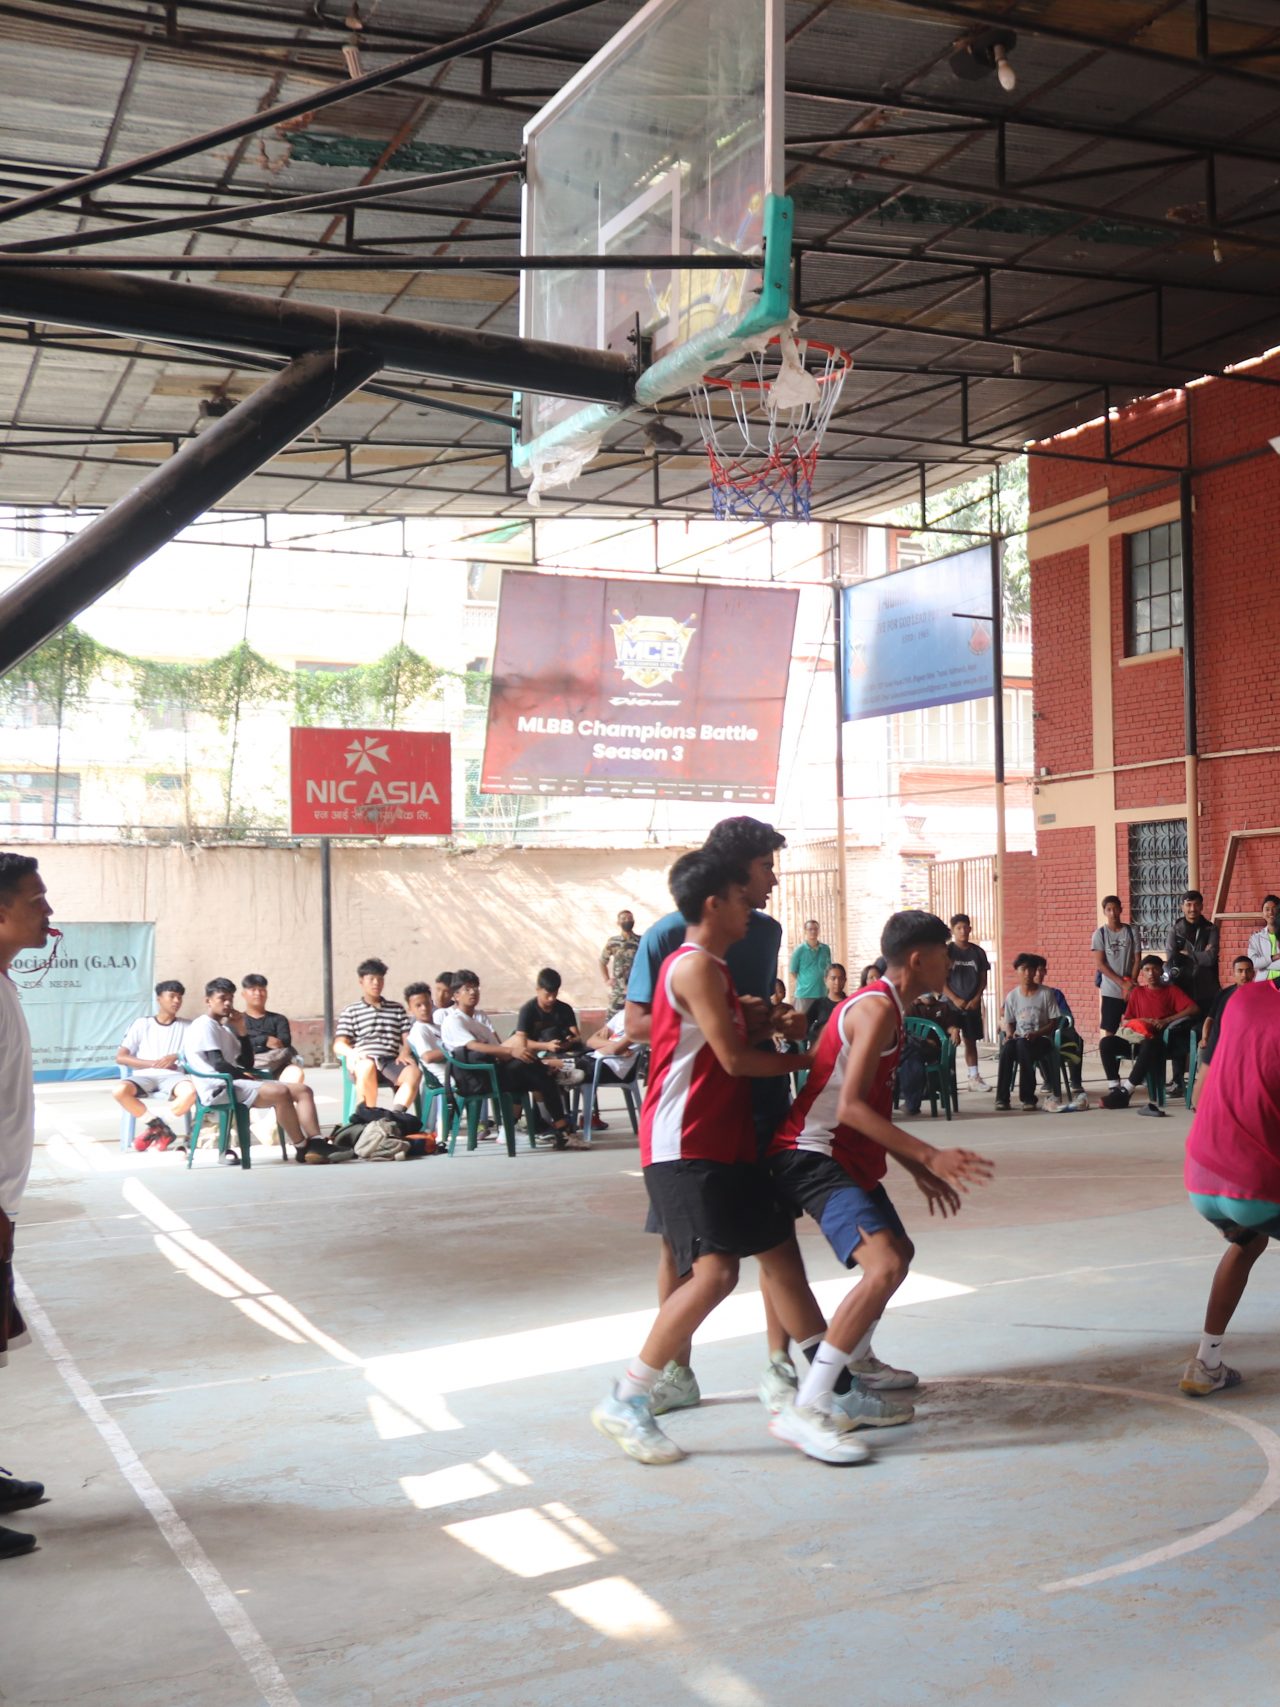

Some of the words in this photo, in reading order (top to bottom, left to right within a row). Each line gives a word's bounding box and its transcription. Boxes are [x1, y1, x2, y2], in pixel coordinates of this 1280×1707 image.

[518, 716, 574, 735] MLBB
[578, 719, 697, 743] Champions
[700, 723, 759, 742] Battle
[592, 743, 668, 761] Season
[671, 745, 684, 761] 3
[306, 780, 357, 803] NIC
[365, 781, 440, 805] ASIA
[14, 955, 78, 969] ociation
